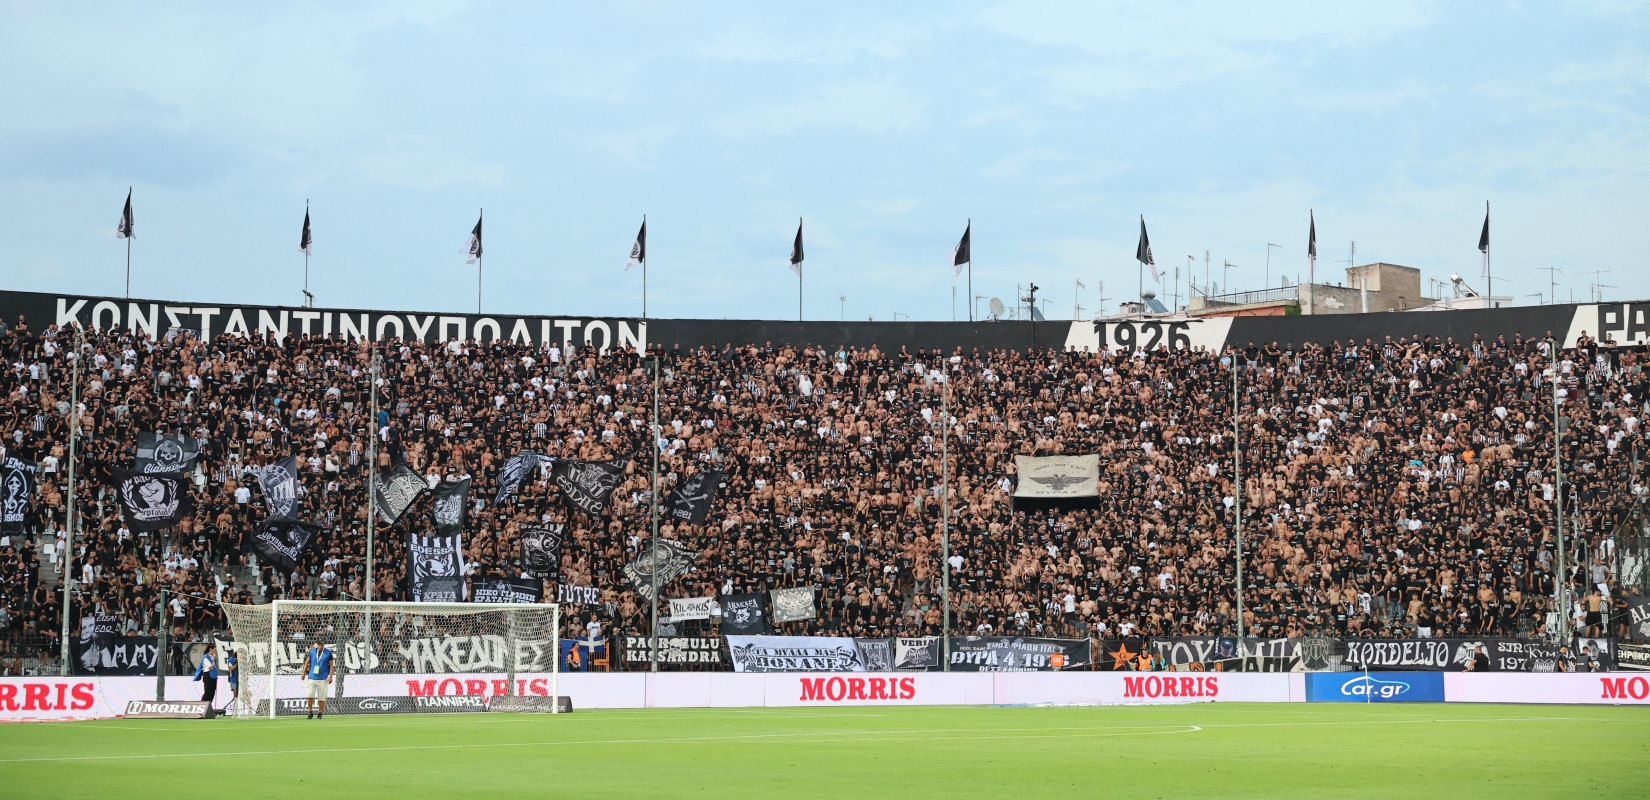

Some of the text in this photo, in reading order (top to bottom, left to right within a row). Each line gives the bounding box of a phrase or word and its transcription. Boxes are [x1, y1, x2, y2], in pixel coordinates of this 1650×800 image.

[1094, 323, 1191, 351] 1926
[558, 583, 601, 605] FUTRE
[1002, 651, 1016, 666] 4
[800, 676, 916, 702] MORRIS
[1123, 675, 1219, 698] MORRIS
[143, 703, 206, 715] MORRIS
